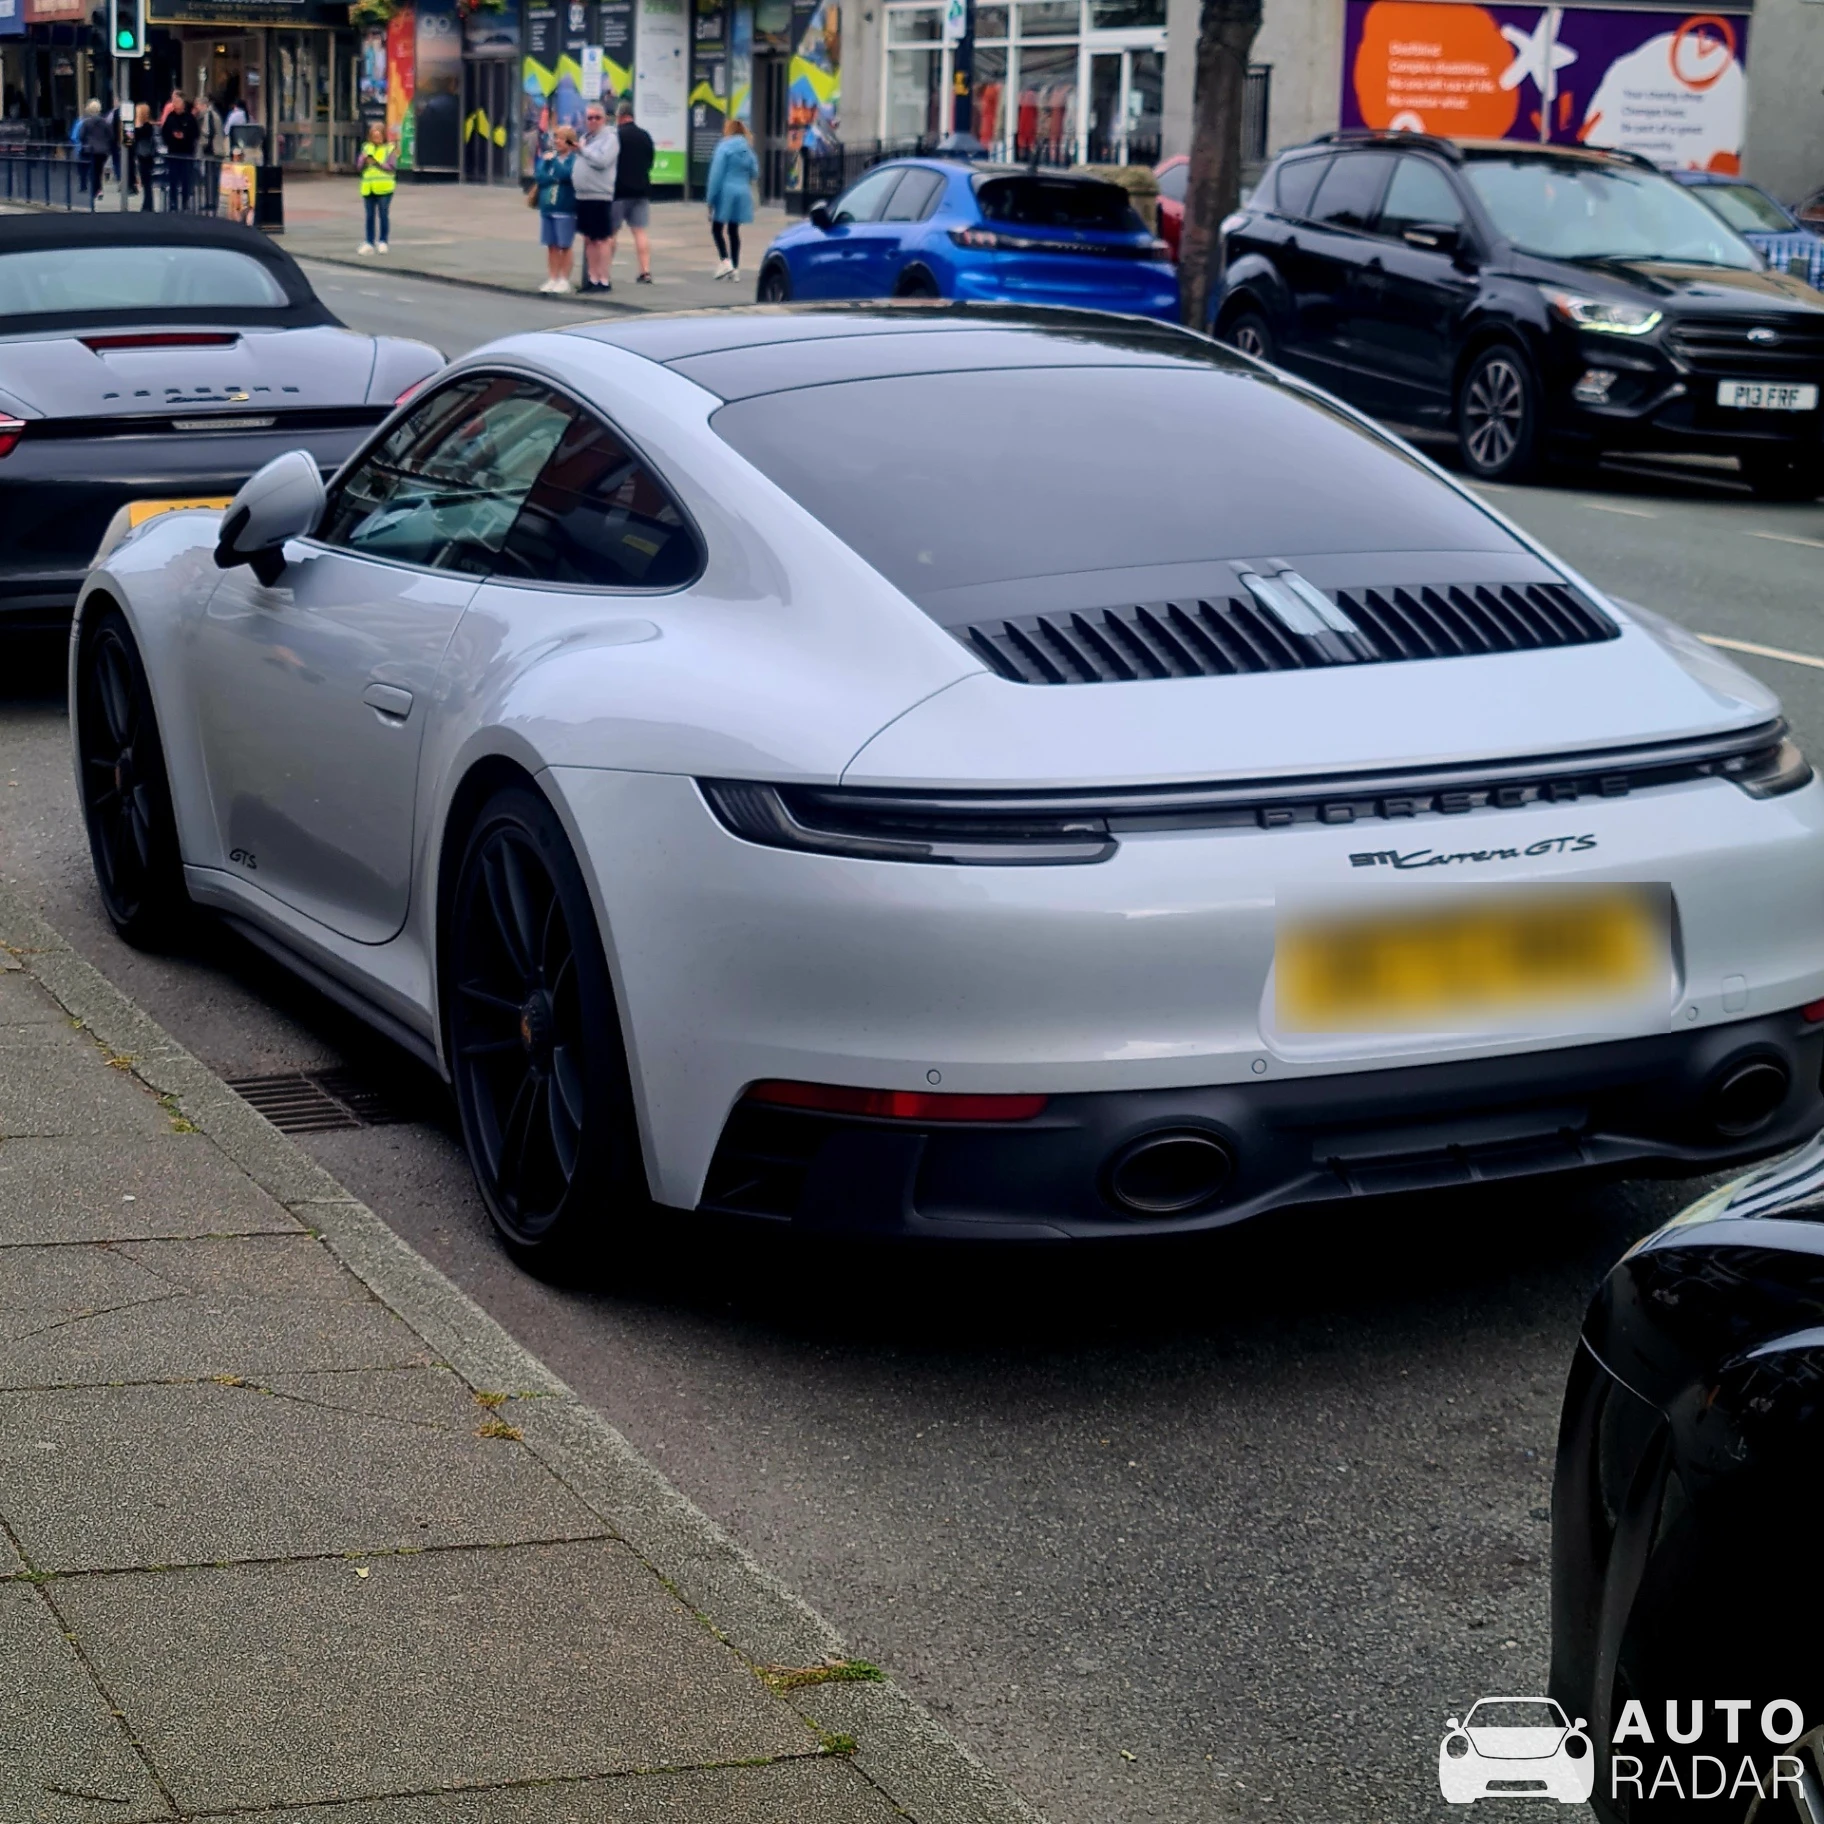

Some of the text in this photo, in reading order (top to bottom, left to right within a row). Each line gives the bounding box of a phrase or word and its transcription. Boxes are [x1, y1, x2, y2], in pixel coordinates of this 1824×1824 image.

[1735, 386, 1799, 406] P13 FRF
[1261, 775, 1630, 829] PORSCHE
[229, 848, 257, 869] GTS
[1394, 849, 1520, 869] Carrera
[1525, 834, 1597, 856] GTS
